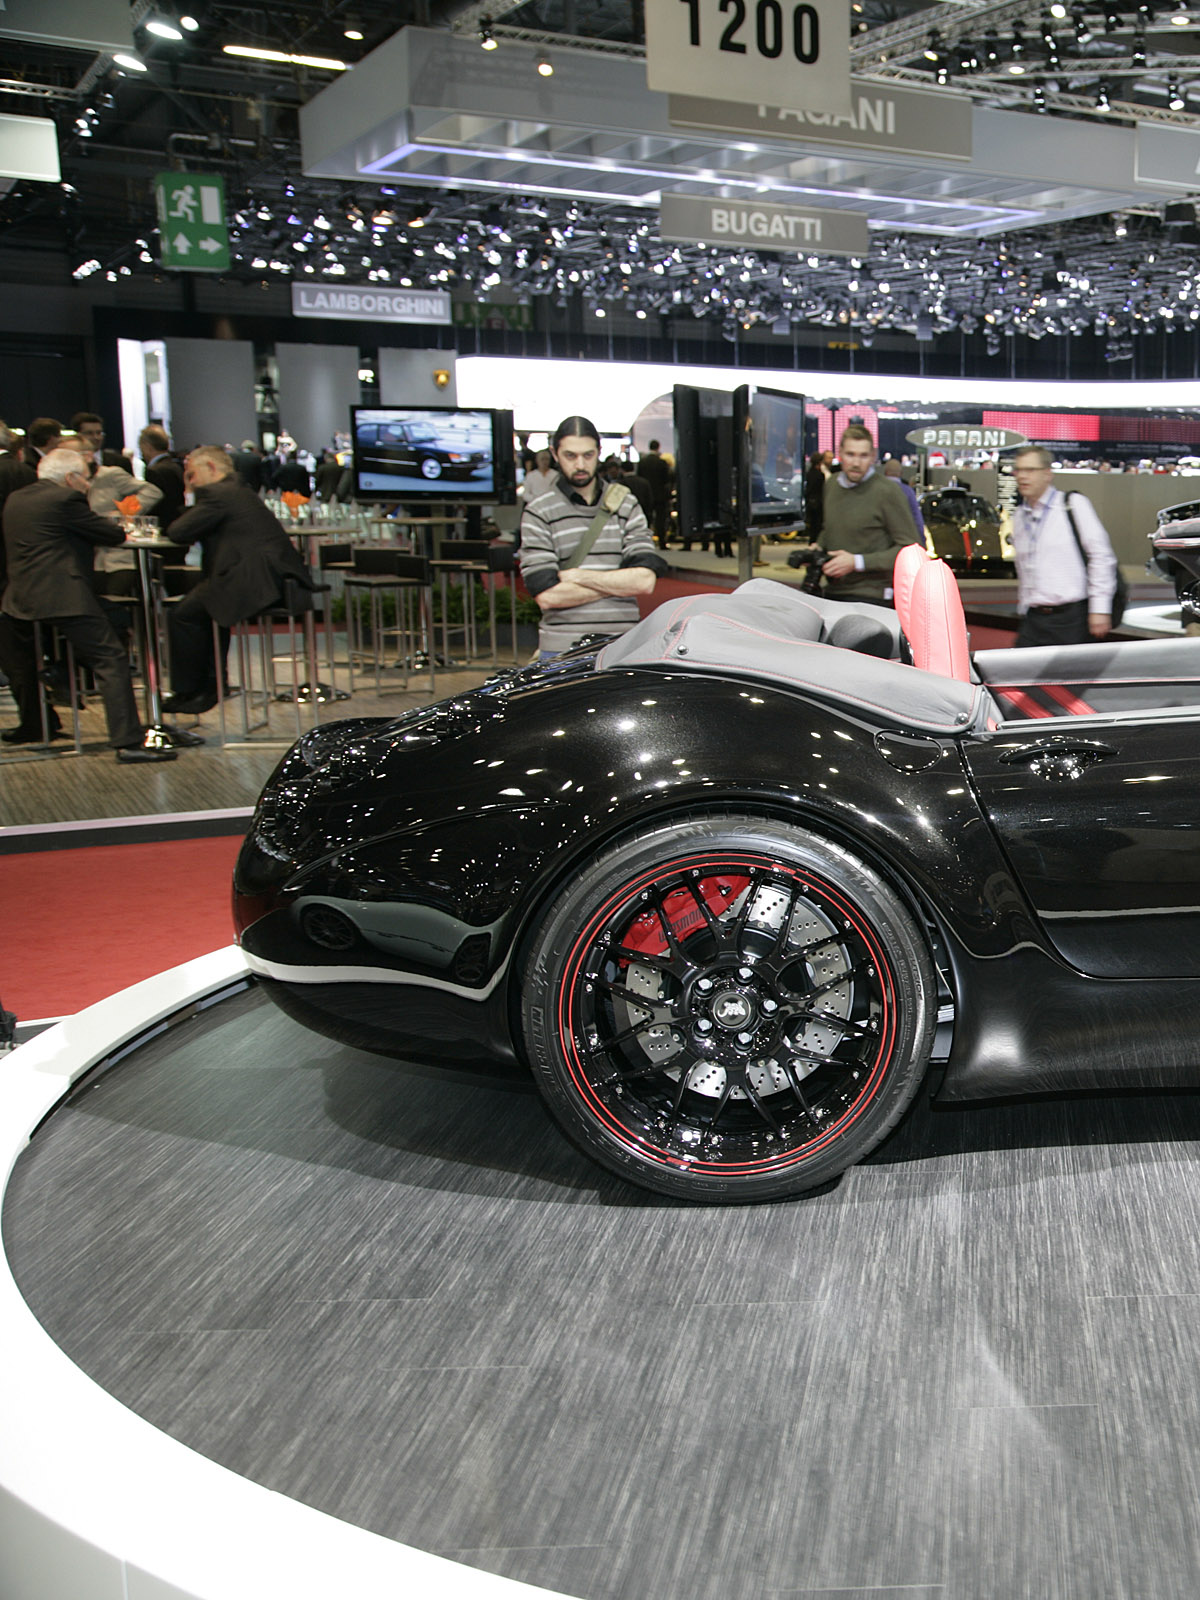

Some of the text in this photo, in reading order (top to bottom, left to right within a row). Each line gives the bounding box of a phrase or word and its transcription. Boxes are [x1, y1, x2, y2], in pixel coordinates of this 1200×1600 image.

[680, 0, 819, 64] 1200
[711, 208, 822, 242] BUGATTI
[300, 291, 445, 316] LAMBORGHINI
